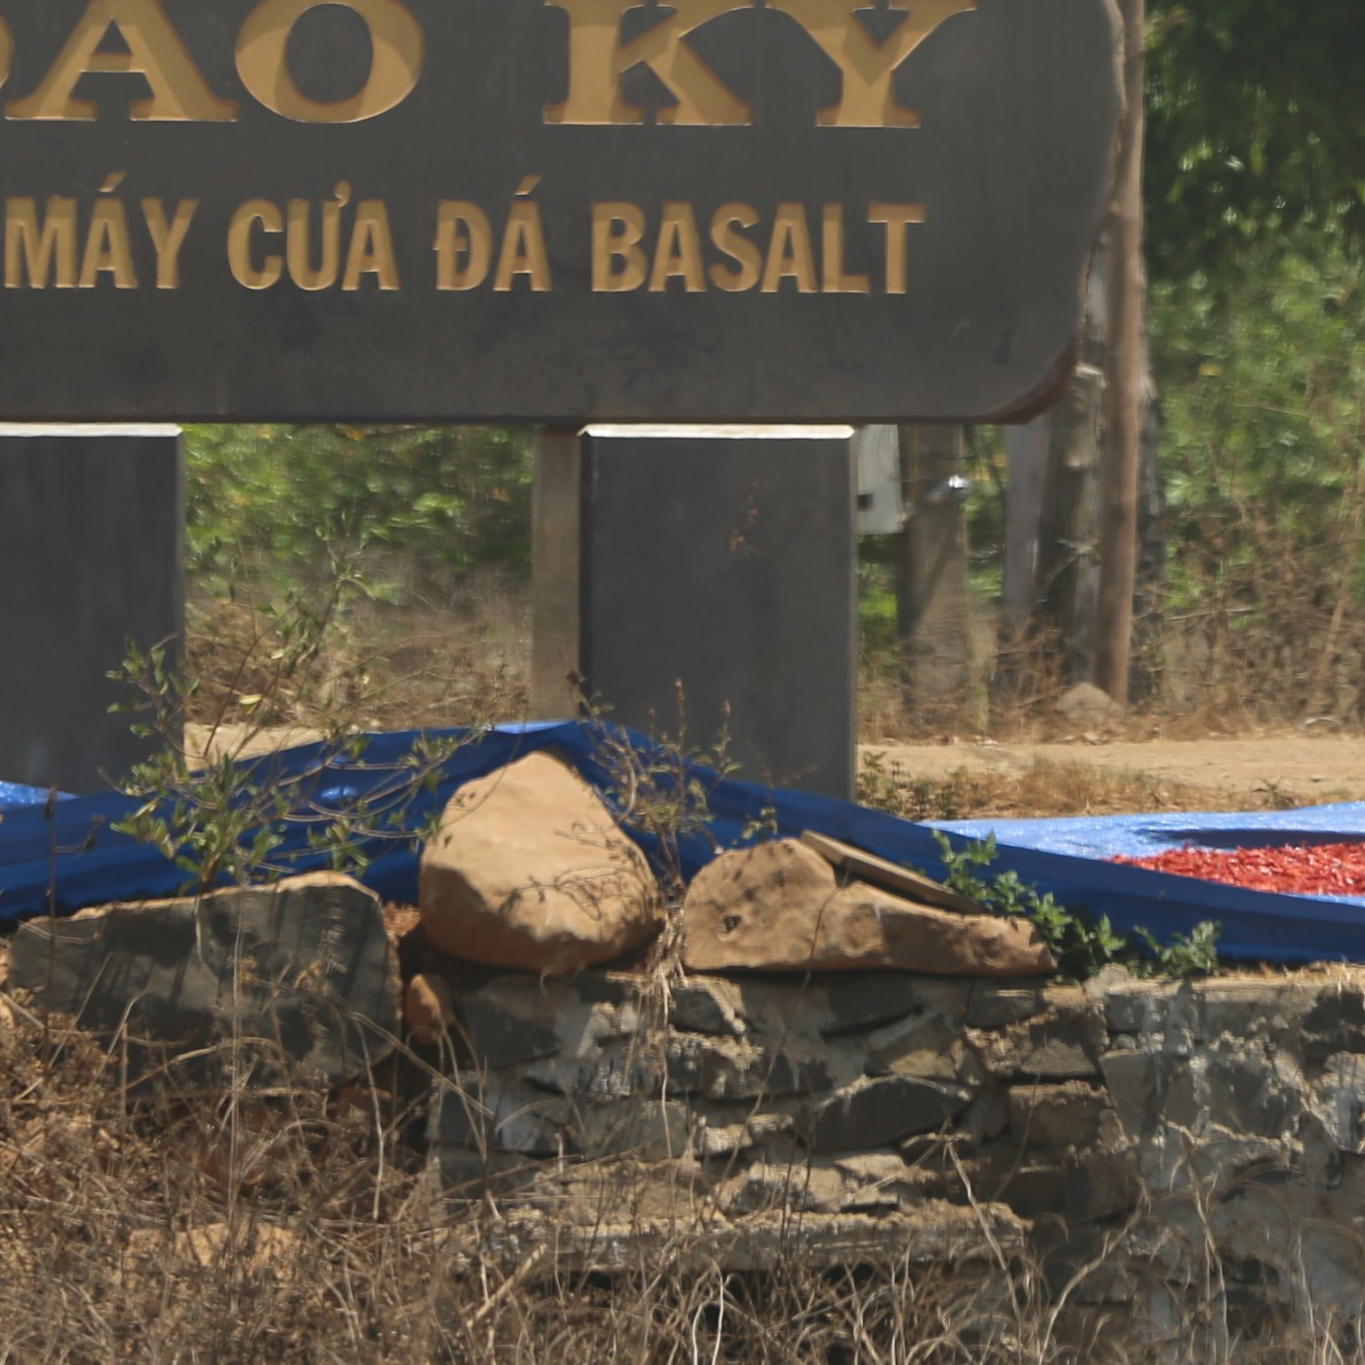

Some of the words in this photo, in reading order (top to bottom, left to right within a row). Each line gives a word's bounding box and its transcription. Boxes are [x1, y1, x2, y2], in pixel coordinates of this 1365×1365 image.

[4, 172, 198, 290] MÁY
[227, 181, 400, 292] CƯA
[433, 175, 552, 292] ĐÁ
[591, 202, 926, 294] BASALT
